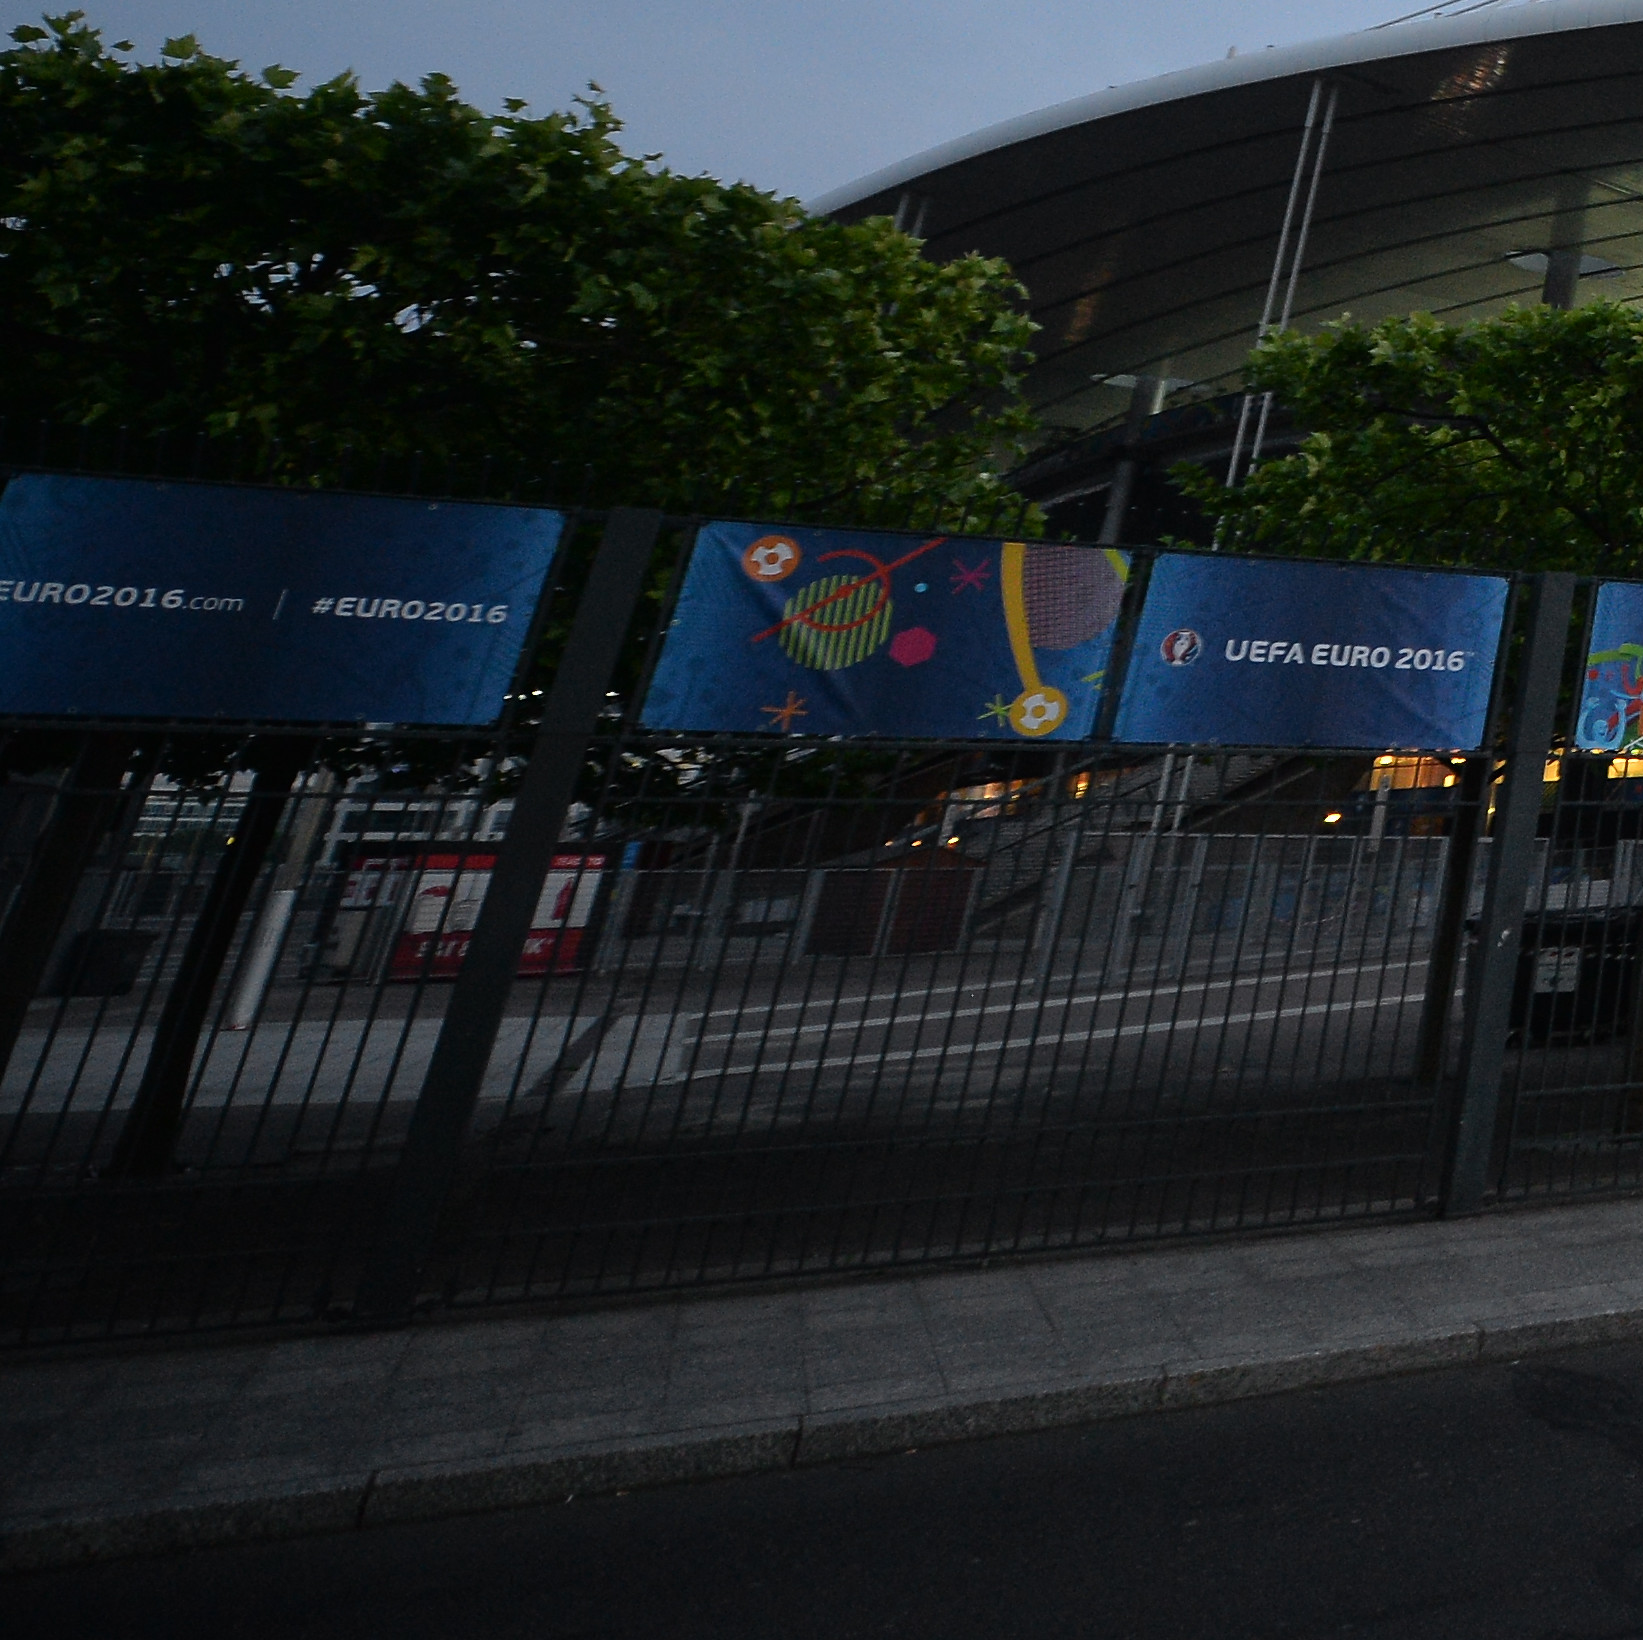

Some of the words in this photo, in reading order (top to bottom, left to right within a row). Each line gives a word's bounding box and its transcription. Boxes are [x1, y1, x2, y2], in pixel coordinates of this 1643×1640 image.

[311, 597, 509, 625] #EURO2016
[1224, 639, 1305, 665] UEFA
[1310, 643, 1391, 669] EURO
[1394, 648, 1467, 672] 2016
